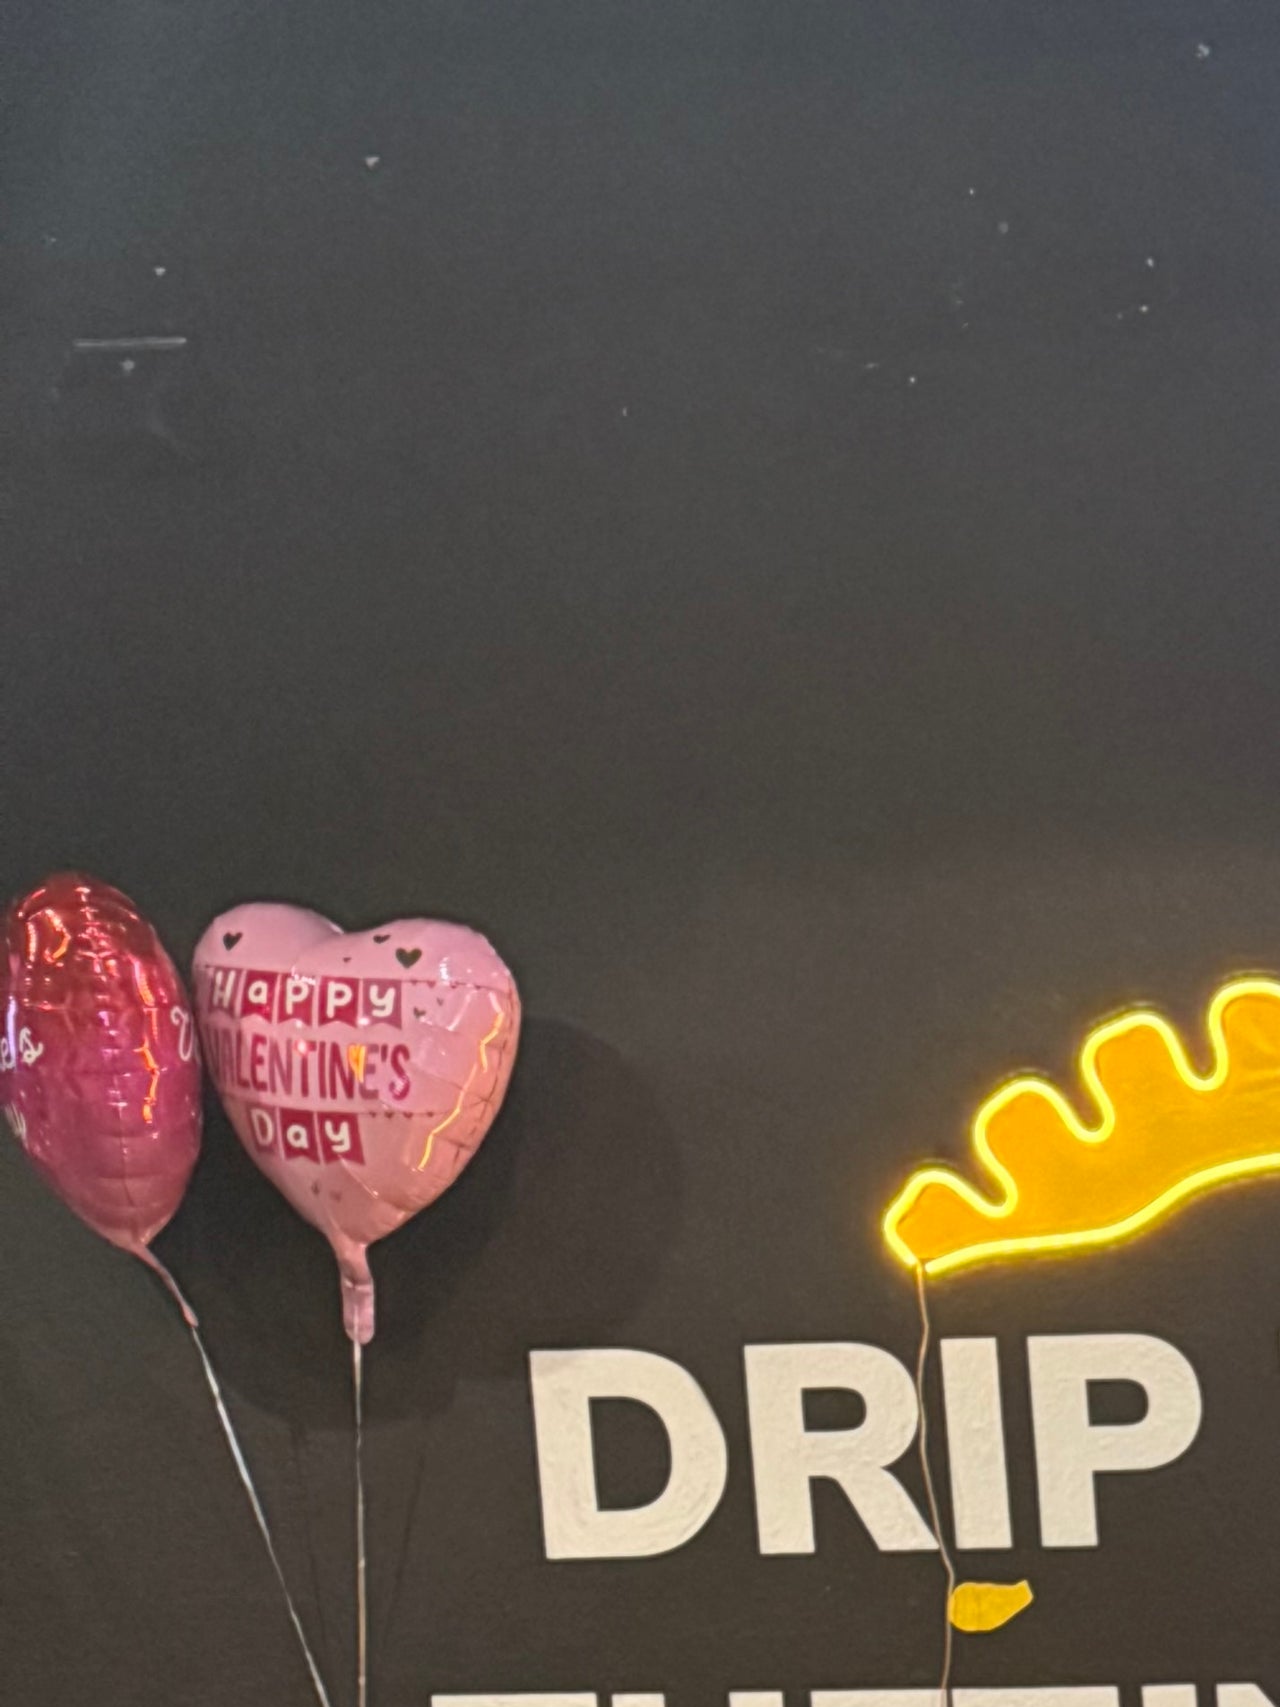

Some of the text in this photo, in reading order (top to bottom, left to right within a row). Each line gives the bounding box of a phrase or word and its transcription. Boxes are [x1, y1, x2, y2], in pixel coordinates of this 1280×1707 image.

[212, 969, 396, 1018] Happy
[251, 1108, 352, 1153] Day
[530, 1333, 1202, 1561] DRIP
